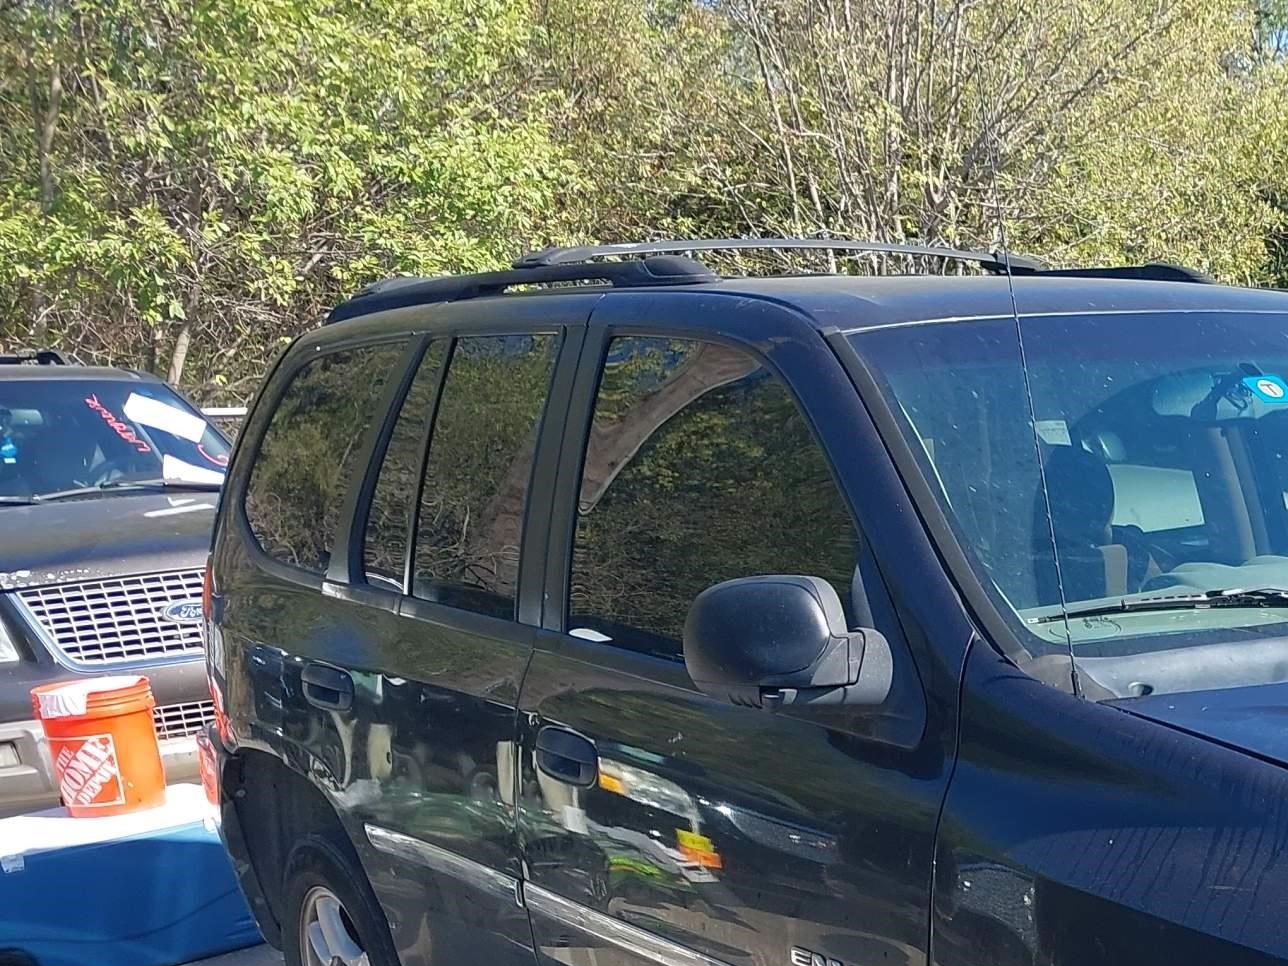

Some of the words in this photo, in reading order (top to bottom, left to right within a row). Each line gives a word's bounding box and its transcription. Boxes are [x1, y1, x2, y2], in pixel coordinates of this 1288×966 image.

[179, 604, 203, 618] For
[56, 745, 75, 773] THE
[61, 737, 113, 806] HOME
